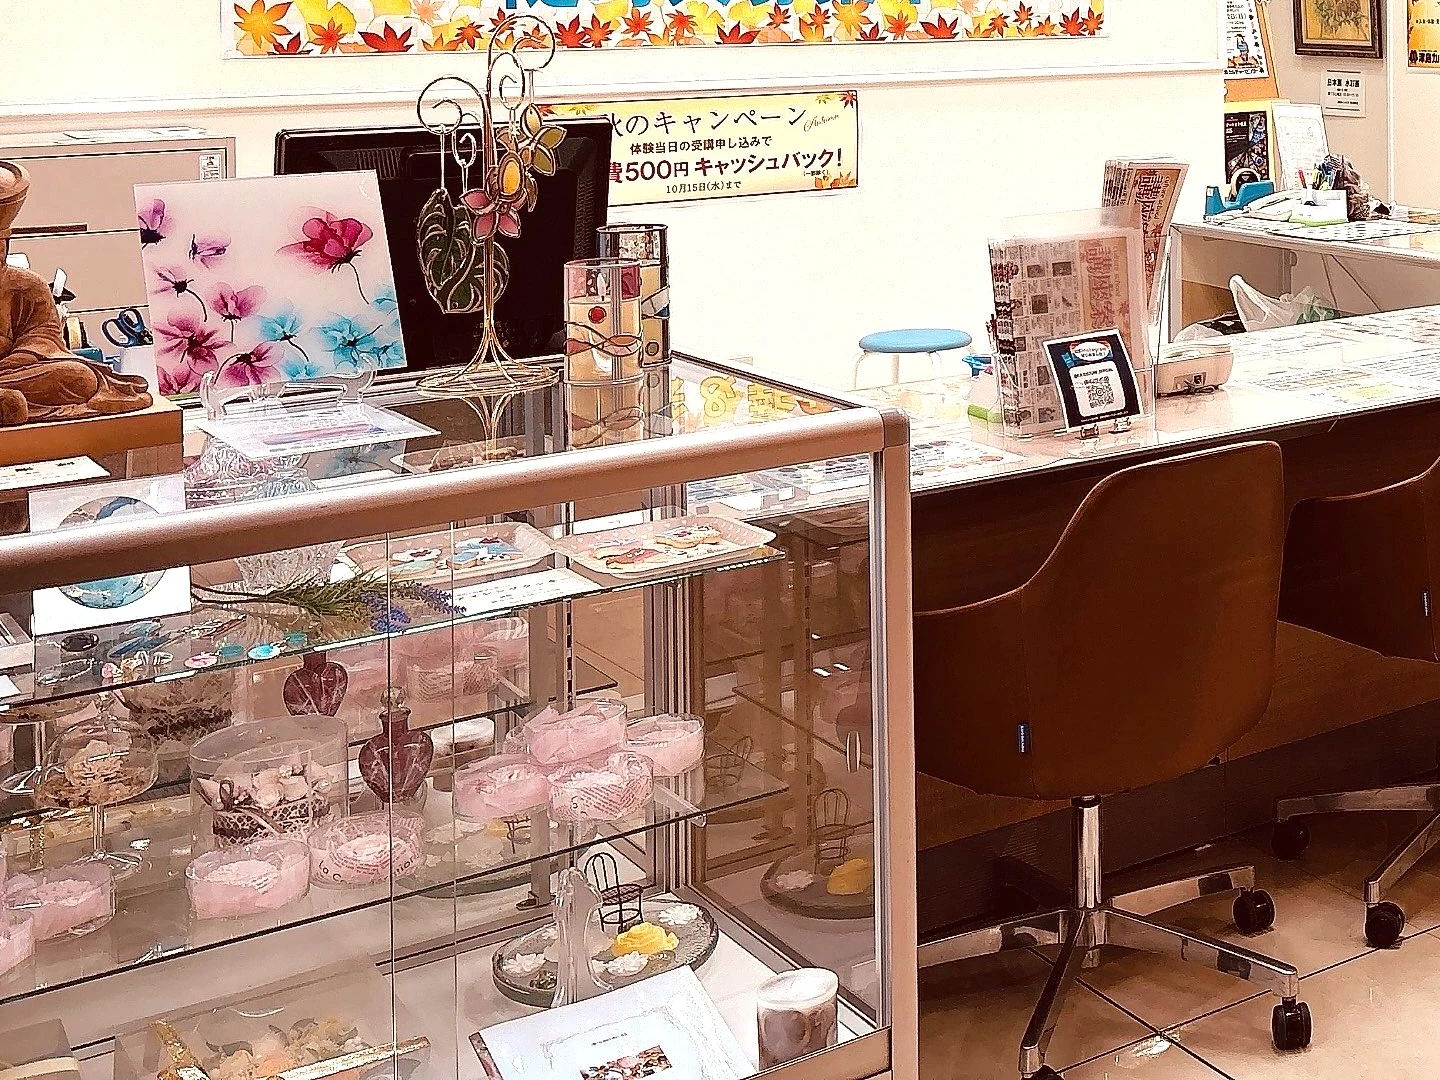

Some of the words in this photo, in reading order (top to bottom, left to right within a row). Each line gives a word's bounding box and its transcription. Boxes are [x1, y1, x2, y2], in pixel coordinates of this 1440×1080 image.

[630, 135, 773, 155] 体験当日の受講申し込みで
[694, 147, 843, 177] キャッシュバック!
[666, 180, 742, 194] 10月15日(水)まで
